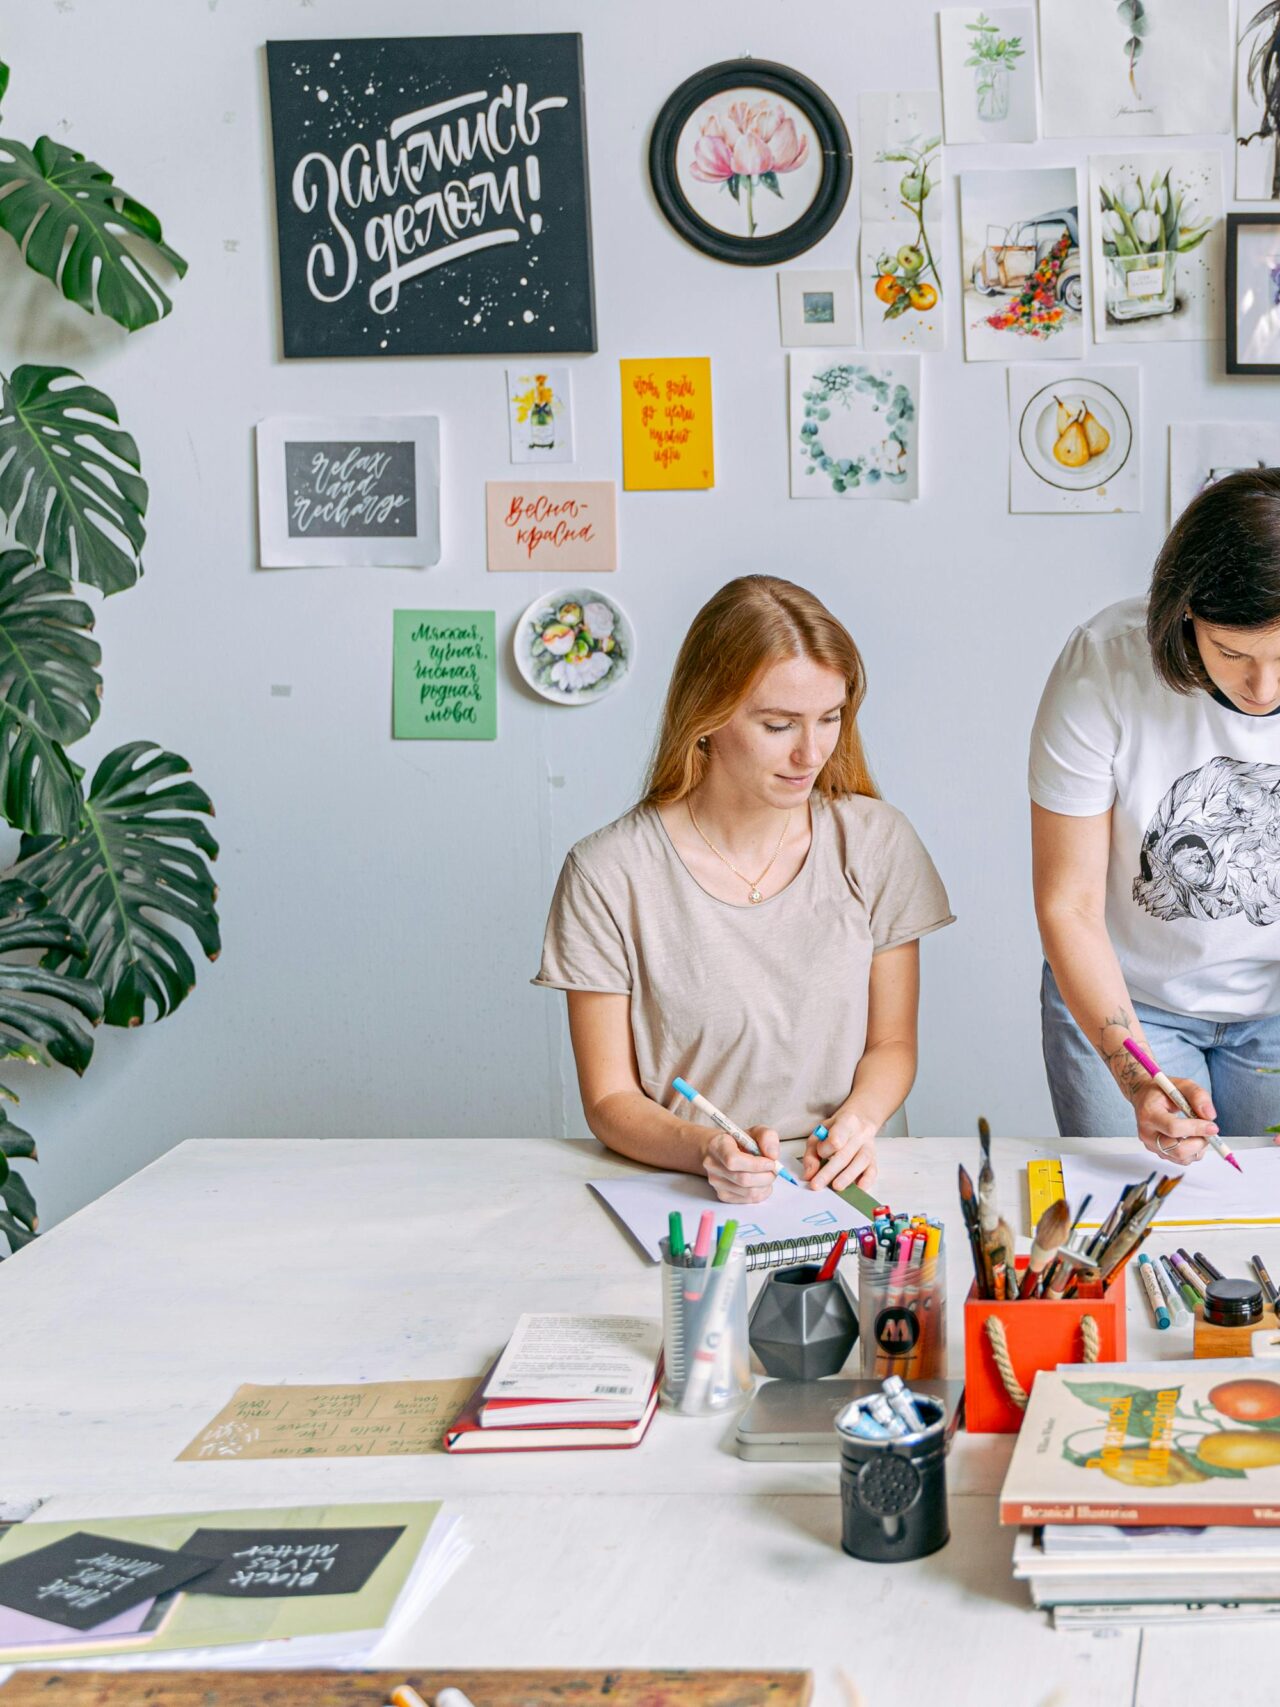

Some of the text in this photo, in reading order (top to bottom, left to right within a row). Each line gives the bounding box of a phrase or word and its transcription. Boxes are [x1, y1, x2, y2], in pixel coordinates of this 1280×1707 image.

[364, 155, 543, 315] делом!
[311, 446, 392, 494] relax
[326, 475, 378, 499] and
[517, 520, 595, 560] красна
[425, 700, 477, 724] мова
[1085, 1396, 1133, 1469] Botanical
[1022, 1505, 1139, 1520] Botanical Illustration
[232, 1543, 340, 1558] Matter
[75, 1552, 165, 1578] Matter
[228, 1570, 320, 1589] Black
[36, 1579, 111, 1609] Black
